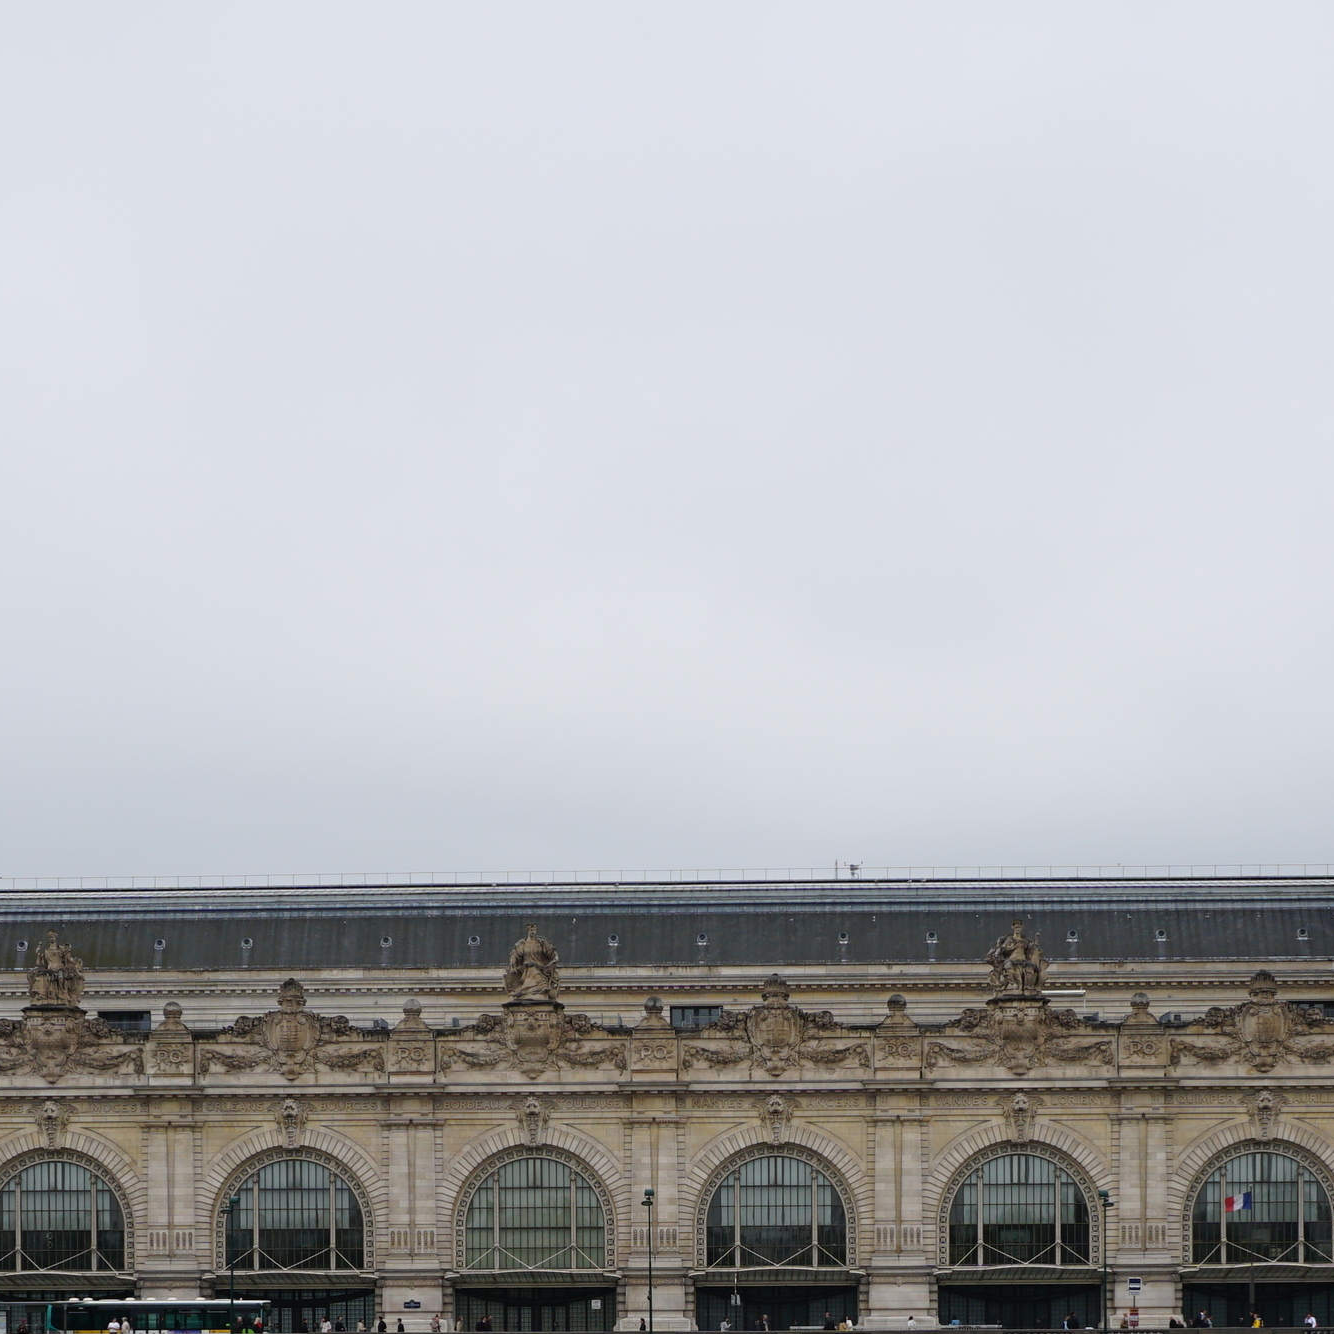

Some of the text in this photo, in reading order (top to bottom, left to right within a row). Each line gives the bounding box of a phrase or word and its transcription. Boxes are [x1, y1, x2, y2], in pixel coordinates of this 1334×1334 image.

[641, 1046, 666, 1058] PO
[885, 1044, 910, 1056] PO
[1130, 1042, 1154, 1054] PO
[157, 1051, 182, 1062] PO
[399, 1048, 424, 1060] PO
[692, 1100, 744, 1108] NANTES
[934, 1096, 988, 1106] VANNES
[1051, 1096, 1106, 1105] LORIENT
[1176, 1094, 1234, 1104] QUIMPER
[206, 1102, 264, 1112] ORLEANS
[444, 1100, 506, 1110] BORDEAUX
[558, 1100, 622, 1109] TOULOUSE
